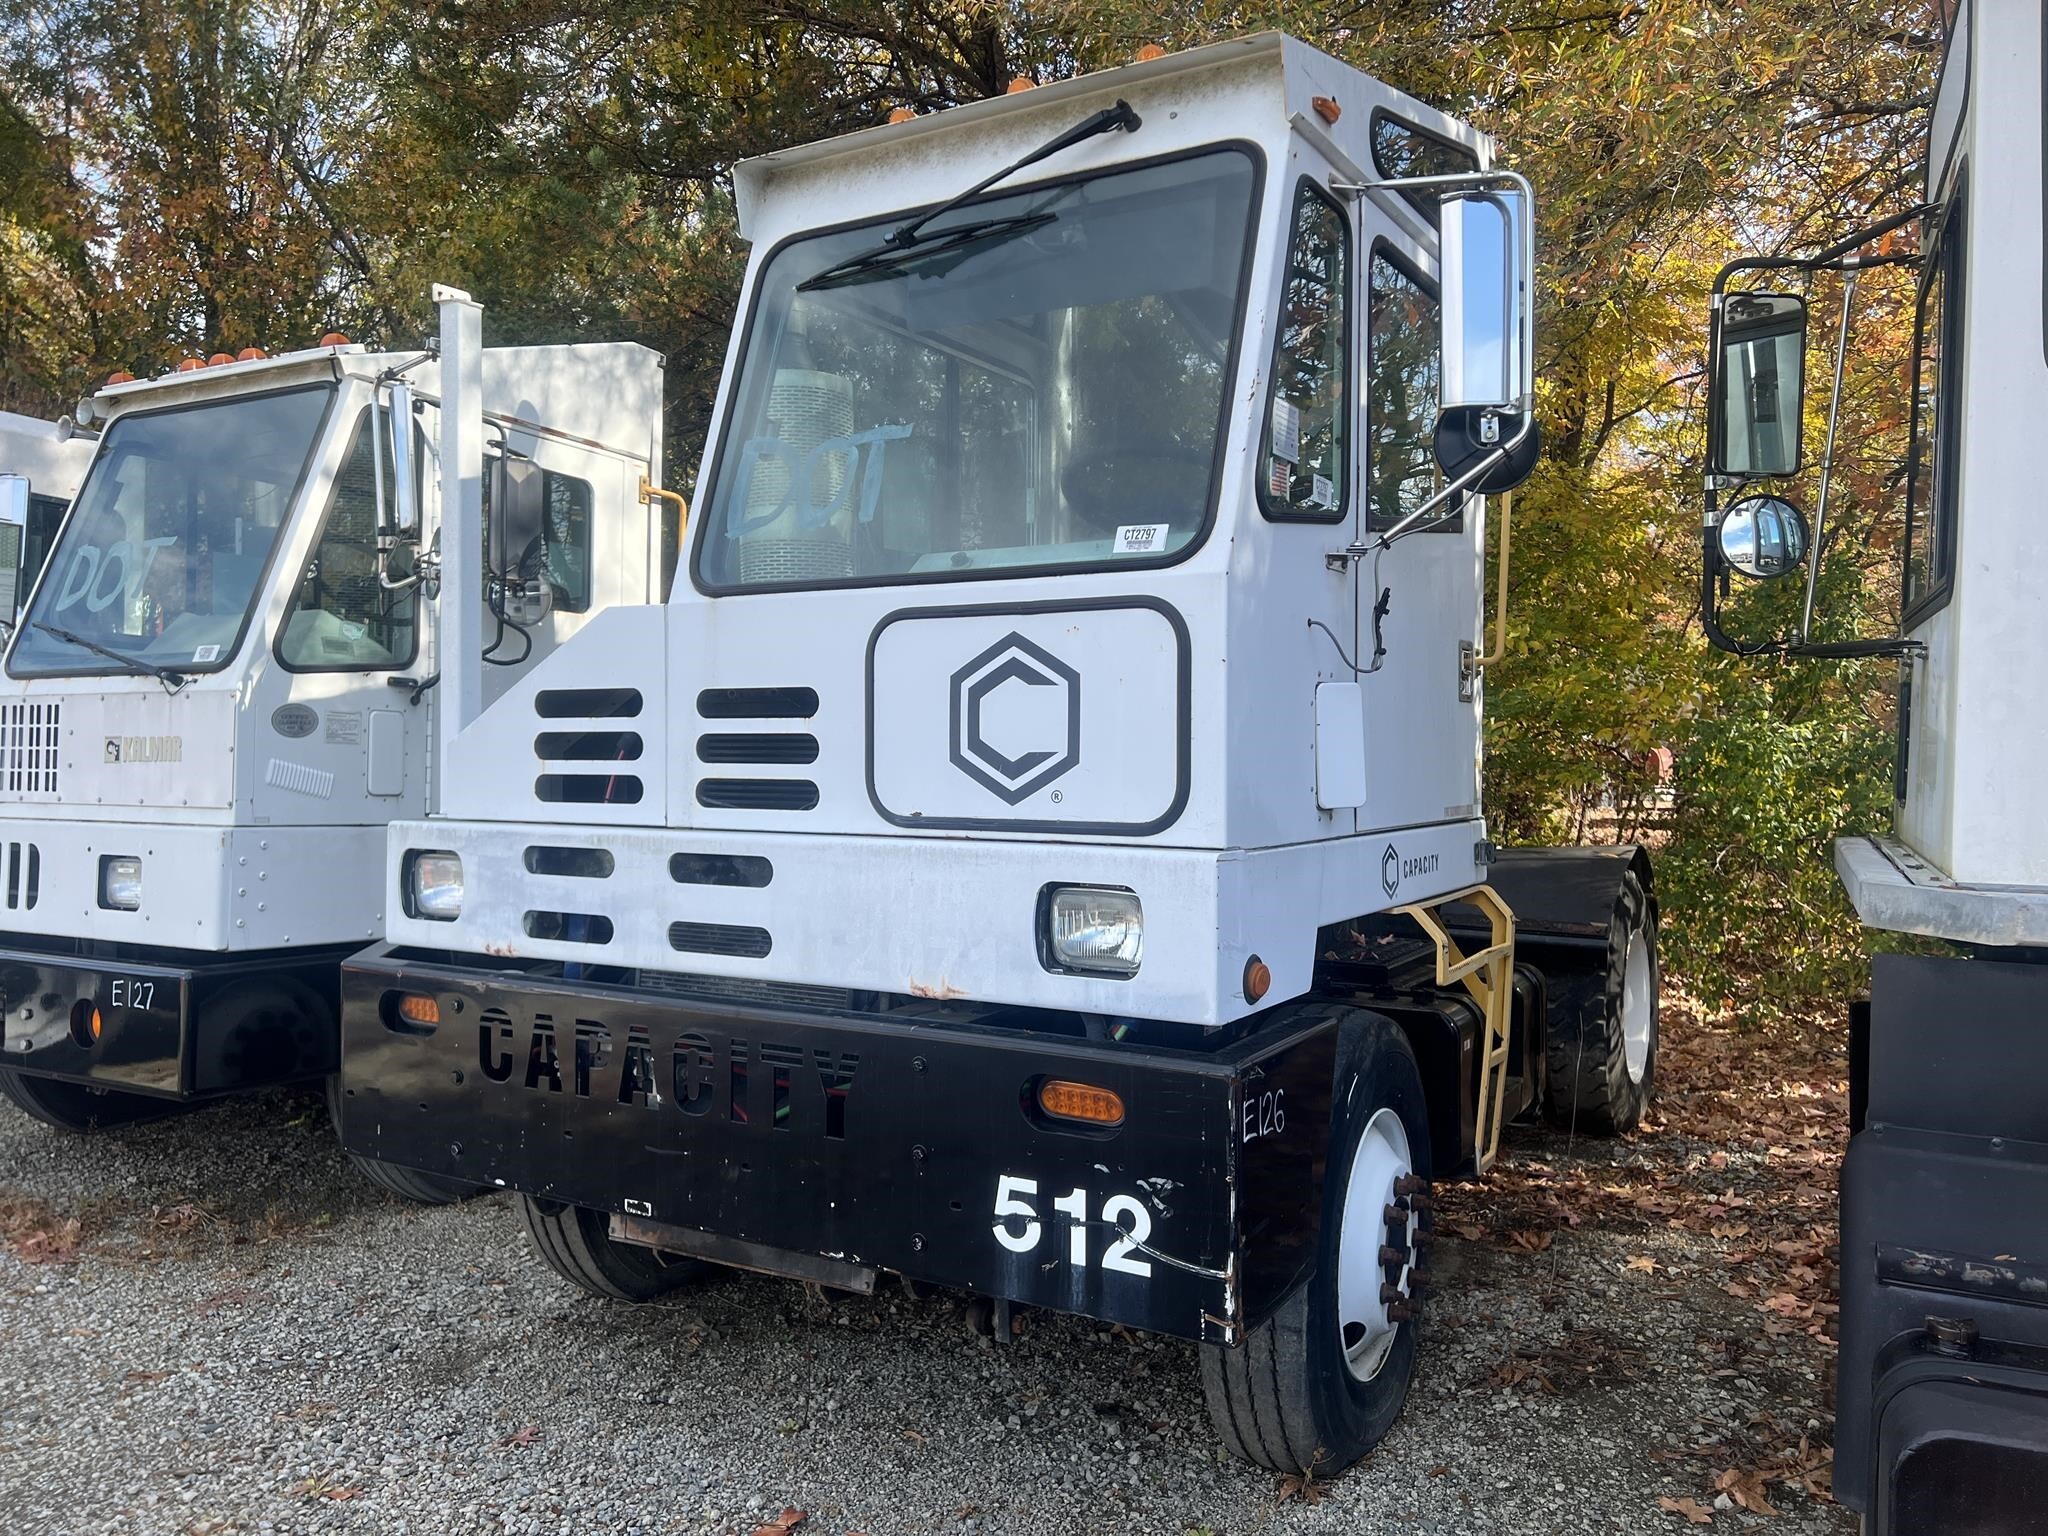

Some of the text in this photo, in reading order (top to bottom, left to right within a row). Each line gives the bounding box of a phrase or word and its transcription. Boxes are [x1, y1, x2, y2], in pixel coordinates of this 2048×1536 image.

[725, 423, 914, 538] DOT
[1124, 528, 1157, 540] CT2797
[56, 535, 178, 612] DOT
[122, 735, 182, 763] KALMAR
[1403, 853, 1439, 879] CAPACITY
[112, 979, 154, 1010] E127
[479, 1006, 860, 1141] CAPACITY
[1243, 1089, 1285, 1143] E126
[992, 1174, 1152, 1278] 512
